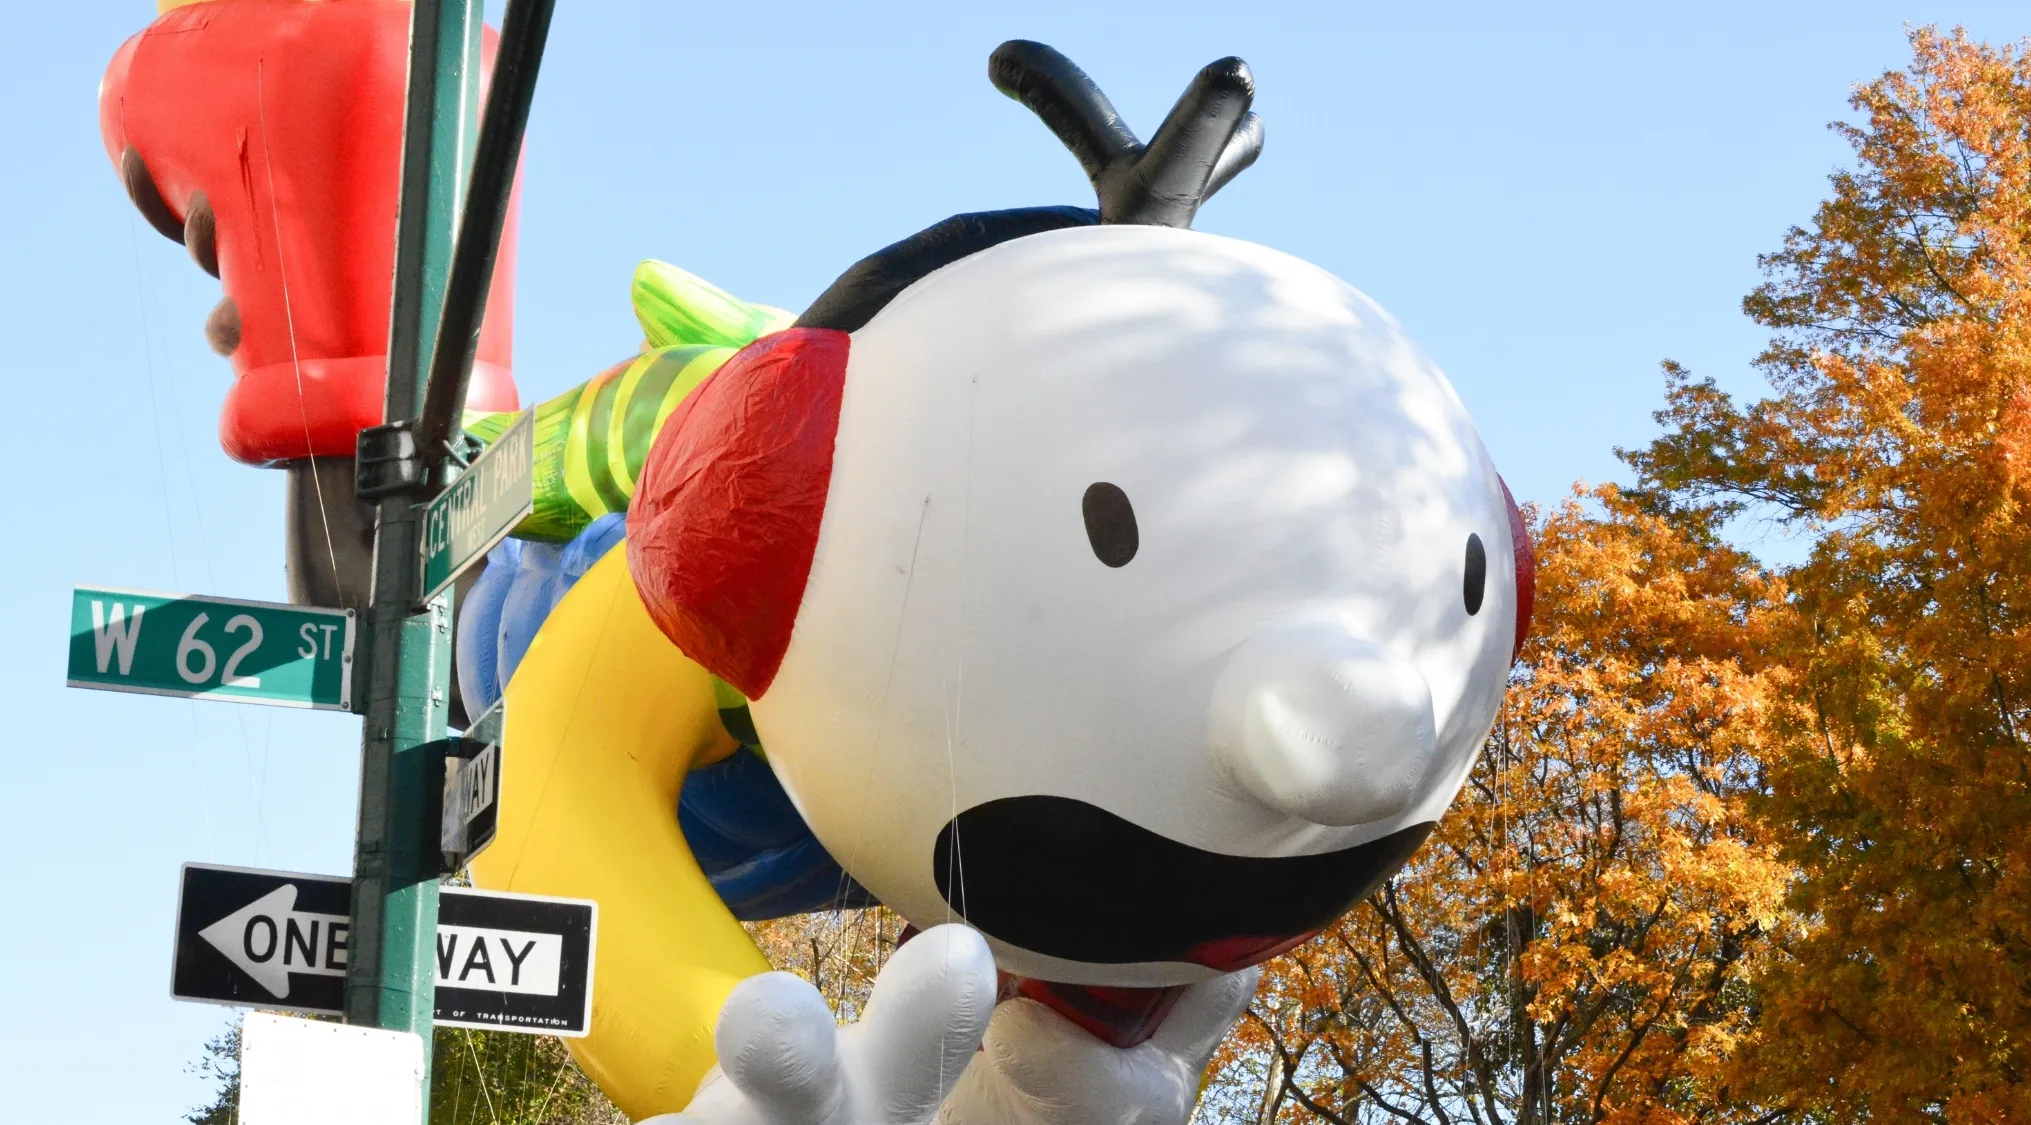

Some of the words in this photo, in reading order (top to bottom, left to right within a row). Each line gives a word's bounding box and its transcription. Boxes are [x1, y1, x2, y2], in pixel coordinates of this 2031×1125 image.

[429, 467, 487, 559] CENTRAL
[494, 426, 527, 502] PARK
[91, 600, 146, 675] W
[176, 612, 264, 688] 62
[297, 622, 339, 660] ST
[243, 914, 350, 970] ONE
[477, 1012, 568, 1026] TRANSPORTATION
